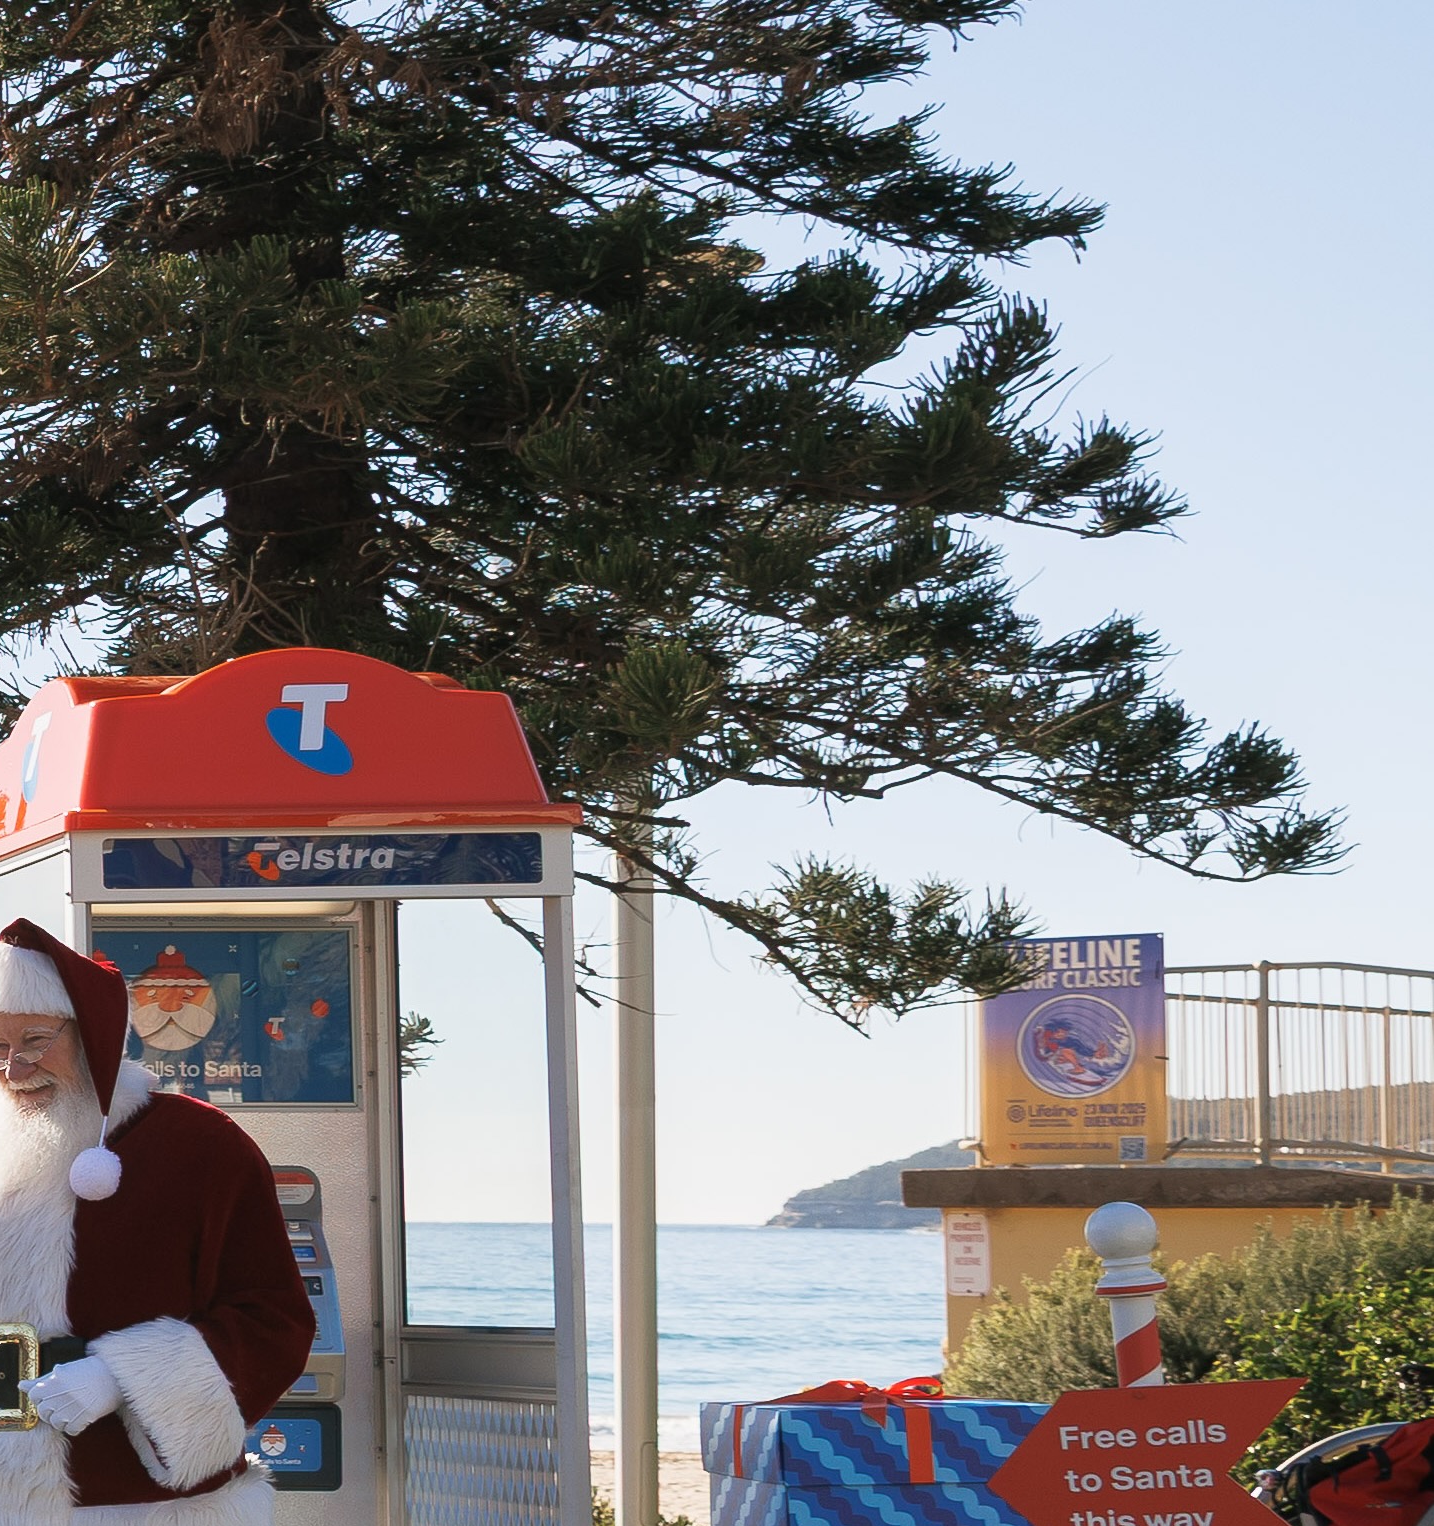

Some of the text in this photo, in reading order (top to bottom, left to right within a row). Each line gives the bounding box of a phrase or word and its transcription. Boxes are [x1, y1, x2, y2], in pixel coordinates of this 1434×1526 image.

[281, 684, 348, 750] T
[24, 711, 52, 782] T
[253, 842, 396, 871] Telstra
[1062, 968, 1141, 989] CLASSIC
[179, 1062, 200, 1078] to
[204, 1060, 262, 1078] Santa
[1059, 1419, 1227, 1450] Free calls
[1064, 1465, 1214, 1493] to Santa
